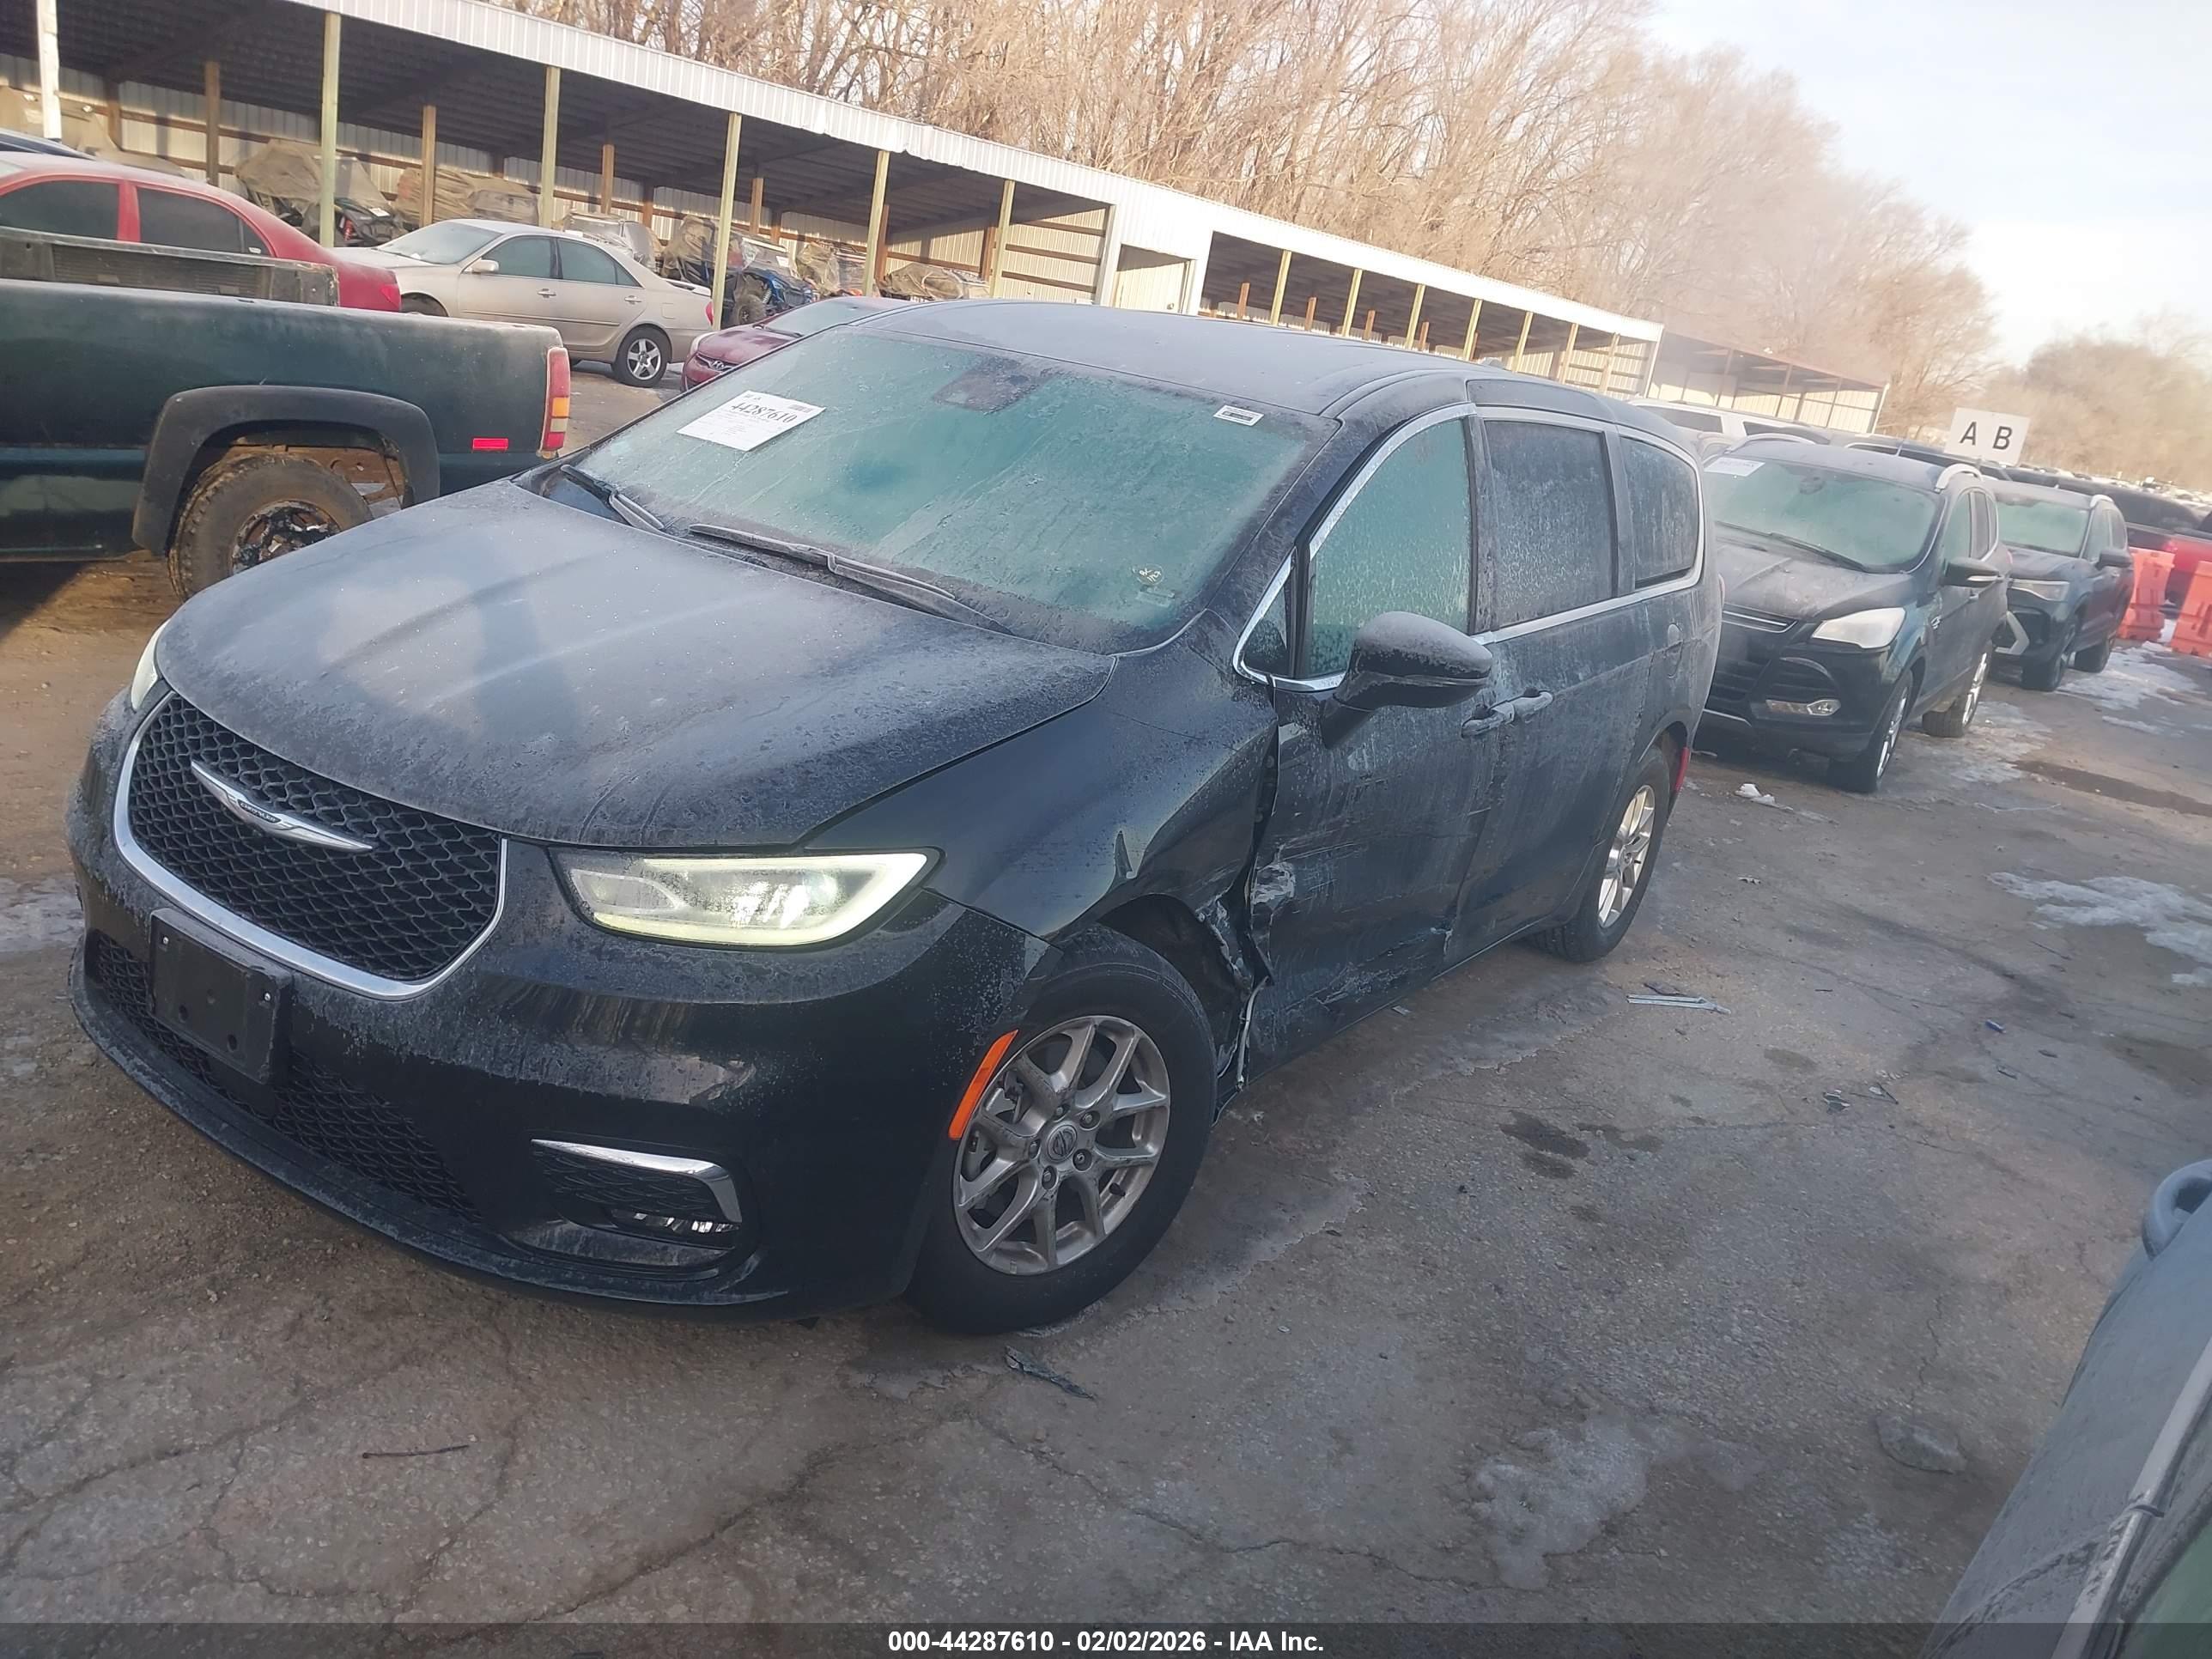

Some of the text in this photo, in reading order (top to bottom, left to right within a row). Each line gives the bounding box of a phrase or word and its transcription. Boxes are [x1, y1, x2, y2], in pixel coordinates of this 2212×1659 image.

[731, 402, 798, 423] 44287610
[1959, 421, 2013, 450] A B
